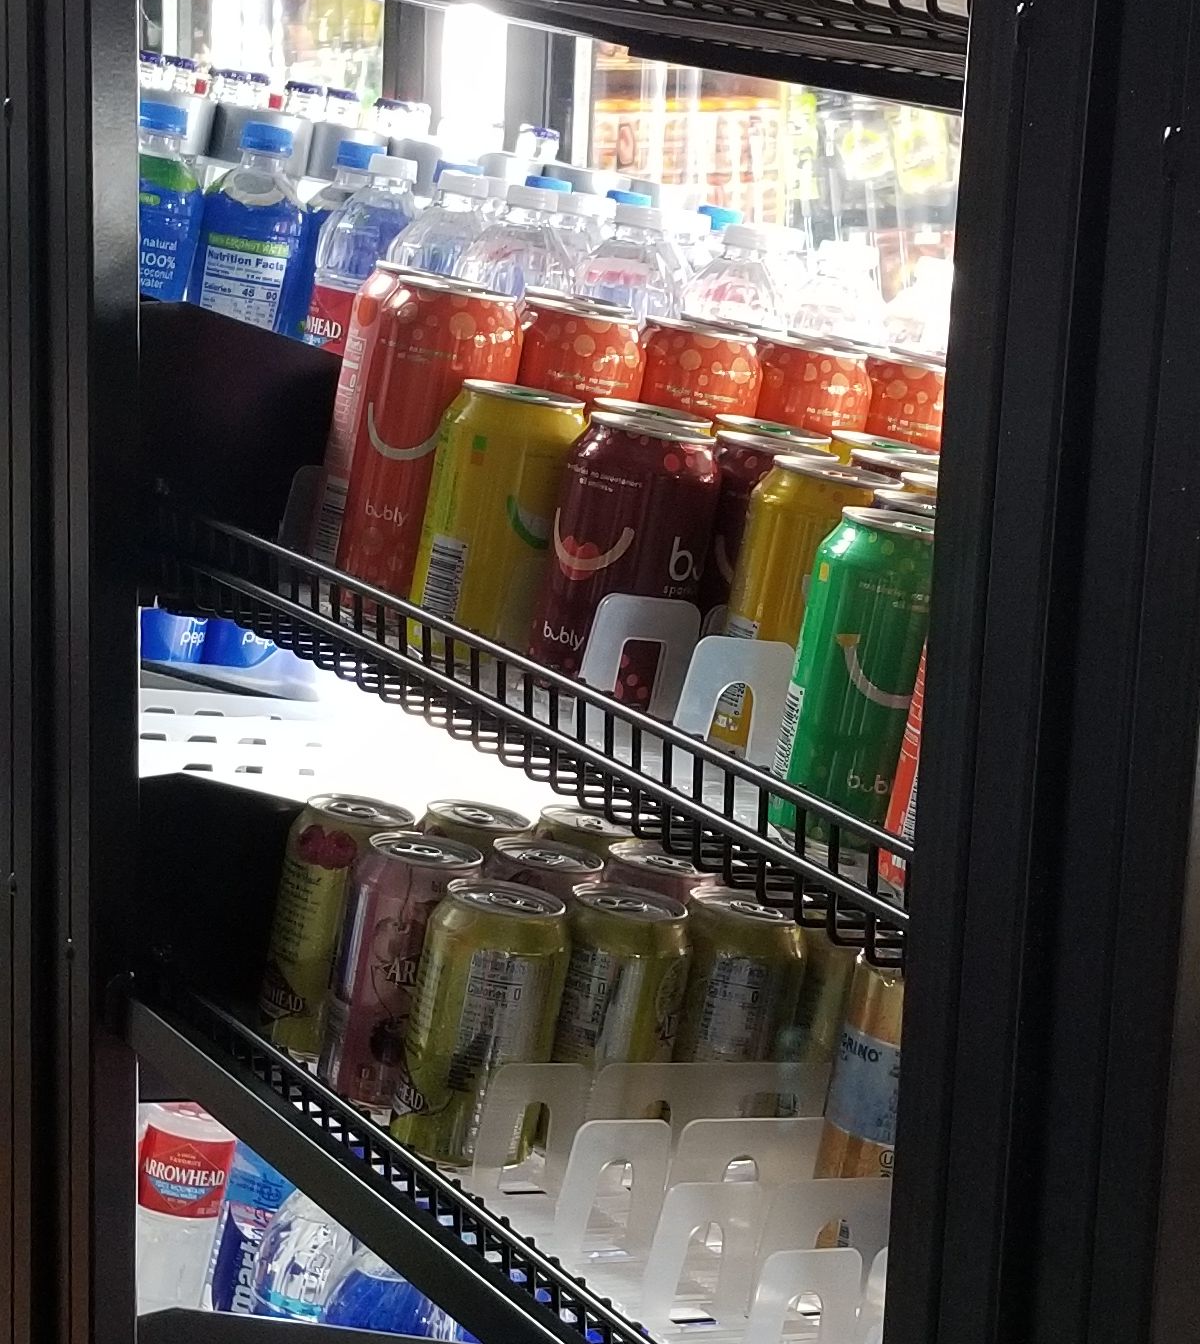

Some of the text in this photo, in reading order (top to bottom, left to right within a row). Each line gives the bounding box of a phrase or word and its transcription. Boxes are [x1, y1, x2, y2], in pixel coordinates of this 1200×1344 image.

[143, 237, 178, 252] natural
[141, 251, 177, 270] 100%
[207, 249, 252, 266] Nutrition
[255, 257, 284, 272] Facts
[364, 499, 408, 527] bubly
[543, 619, 585, 651] bubly
[144, 1157, 225, 1187] ARROWHEAD
